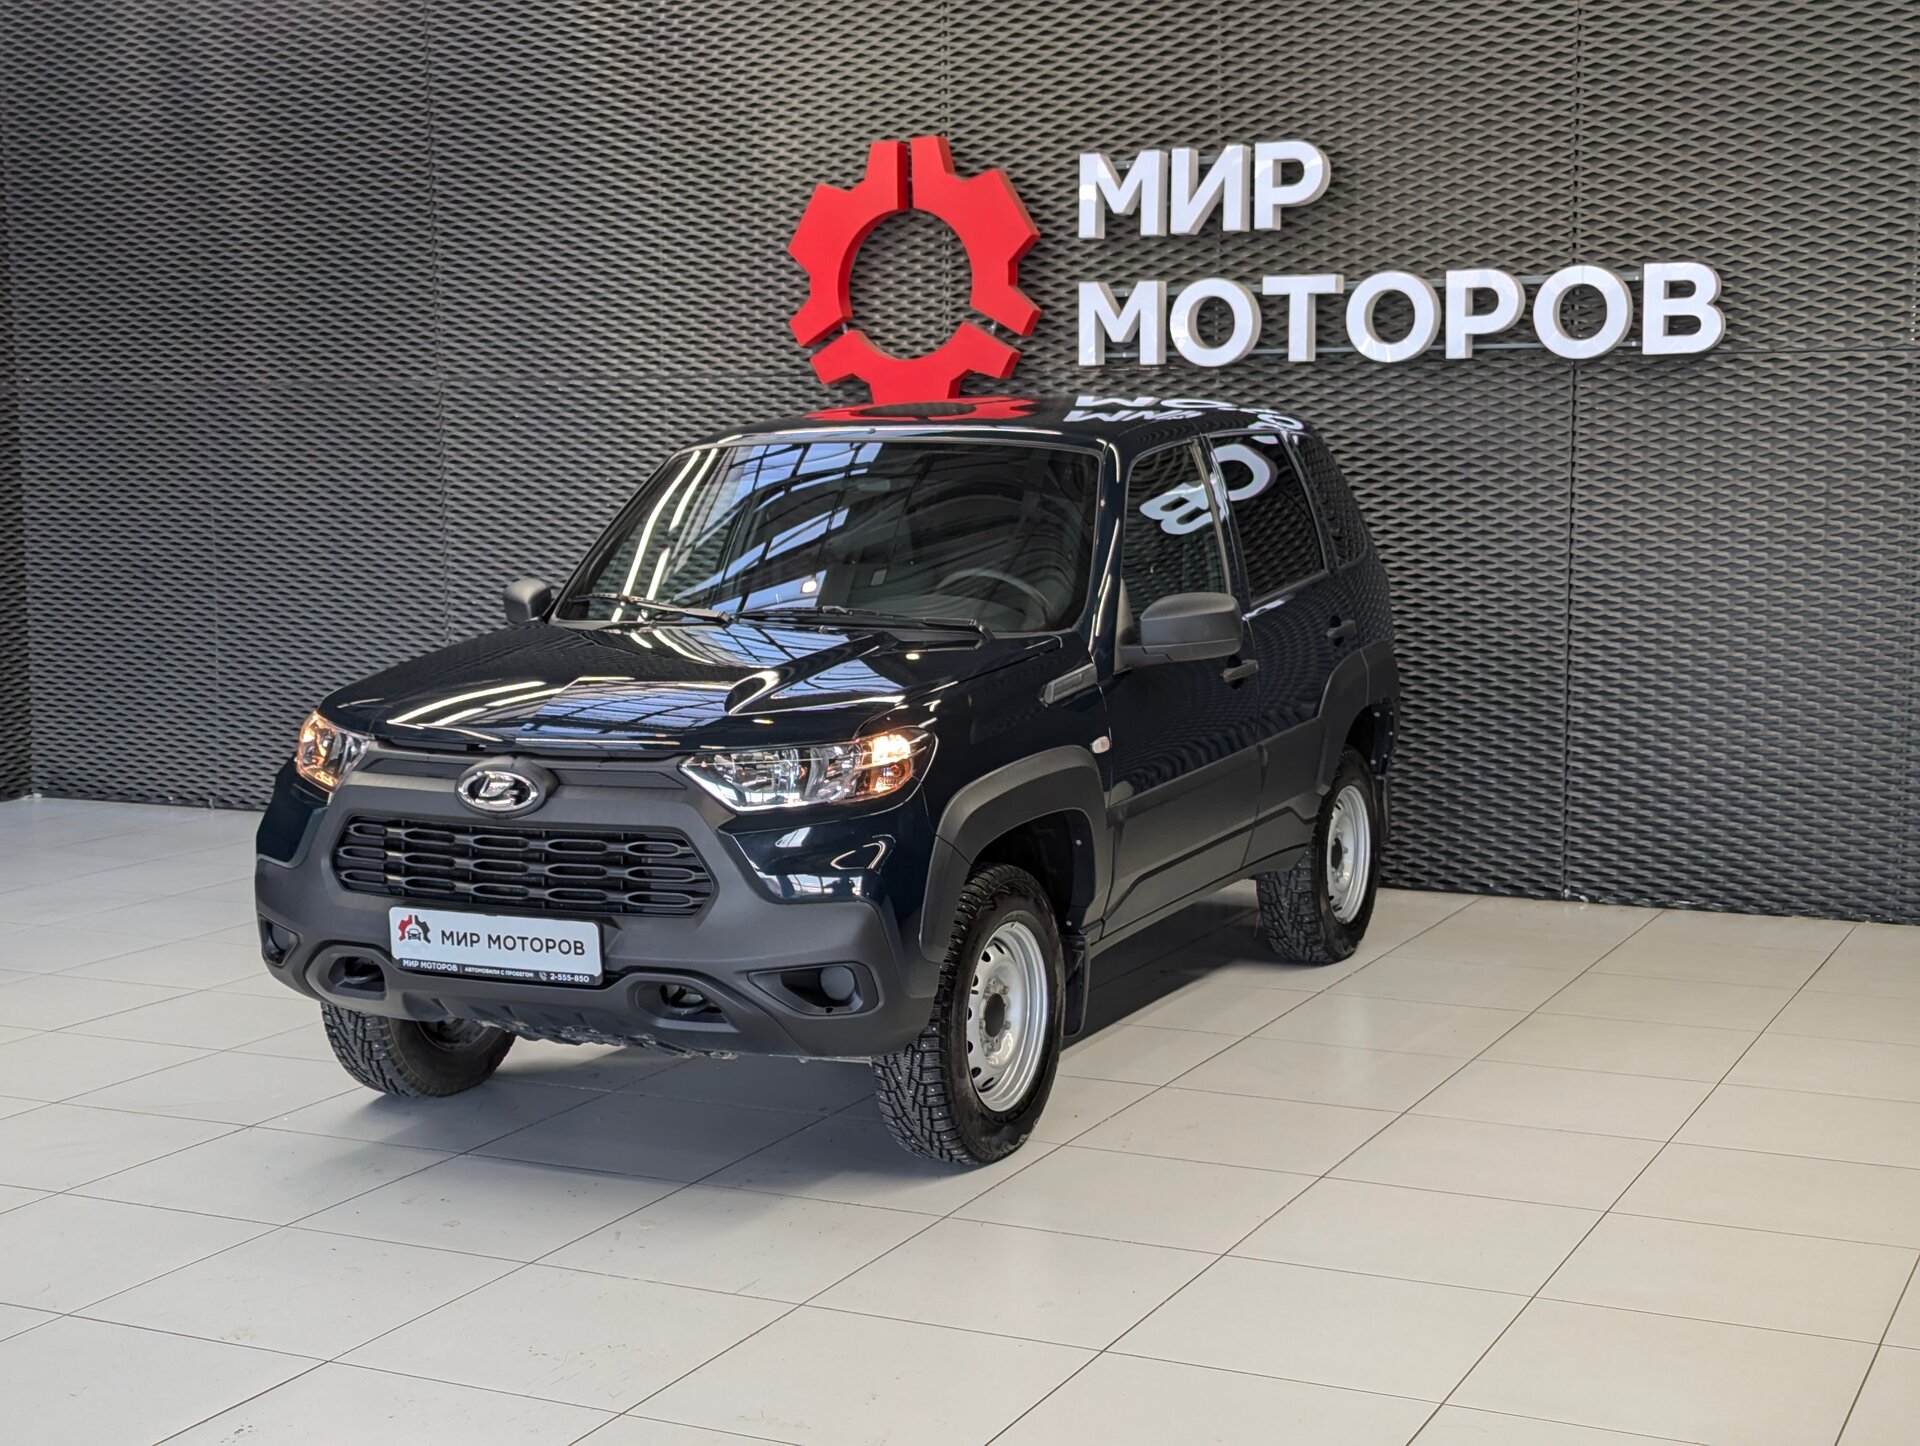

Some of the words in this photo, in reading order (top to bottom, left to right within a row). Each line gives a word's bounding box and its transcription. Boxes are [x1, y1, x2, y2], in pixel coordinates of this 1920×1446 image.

[1078, 140, 1331, 239] МИР
[1078, 262, 1726, 367] МОТОРОВ
[402, 959, 420, 968] МИР
[420, 961, 458, 972] МОТОРОВ
[549, 973, 590, 983] 2-555-850
[441, 930, 481, 947] МИР
[487, 934, 585, 956] МОТОРОВ
